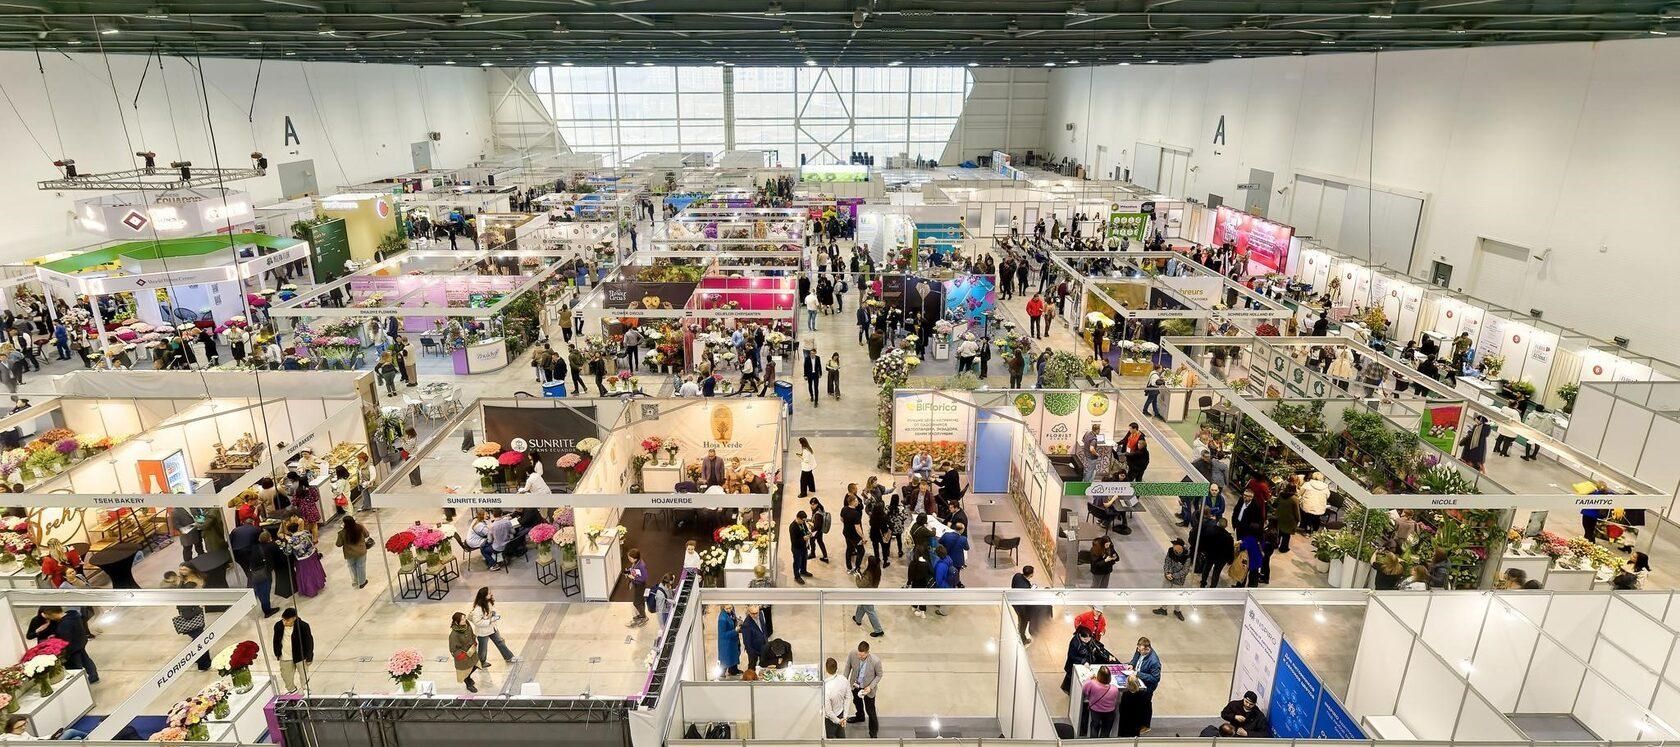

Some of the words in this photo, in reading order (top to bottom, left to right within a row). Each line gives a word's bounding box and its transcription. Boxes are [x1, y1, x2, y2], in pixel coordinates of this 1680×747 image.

[285, 116, 300, 146] A
[1213, 115, 1226, 146] A
[297, 432, 315, 448] BAKERY
[529, 438, 576, 448] SUNRITE
[703, 441, 720, 449] Hoja
[722, 441, 743, 449] Verde
[1290, 440, 1305, 453] NICOLE
[156, 651, 197, 688] FLORISOL
[203, 631, 216, 646] CO
